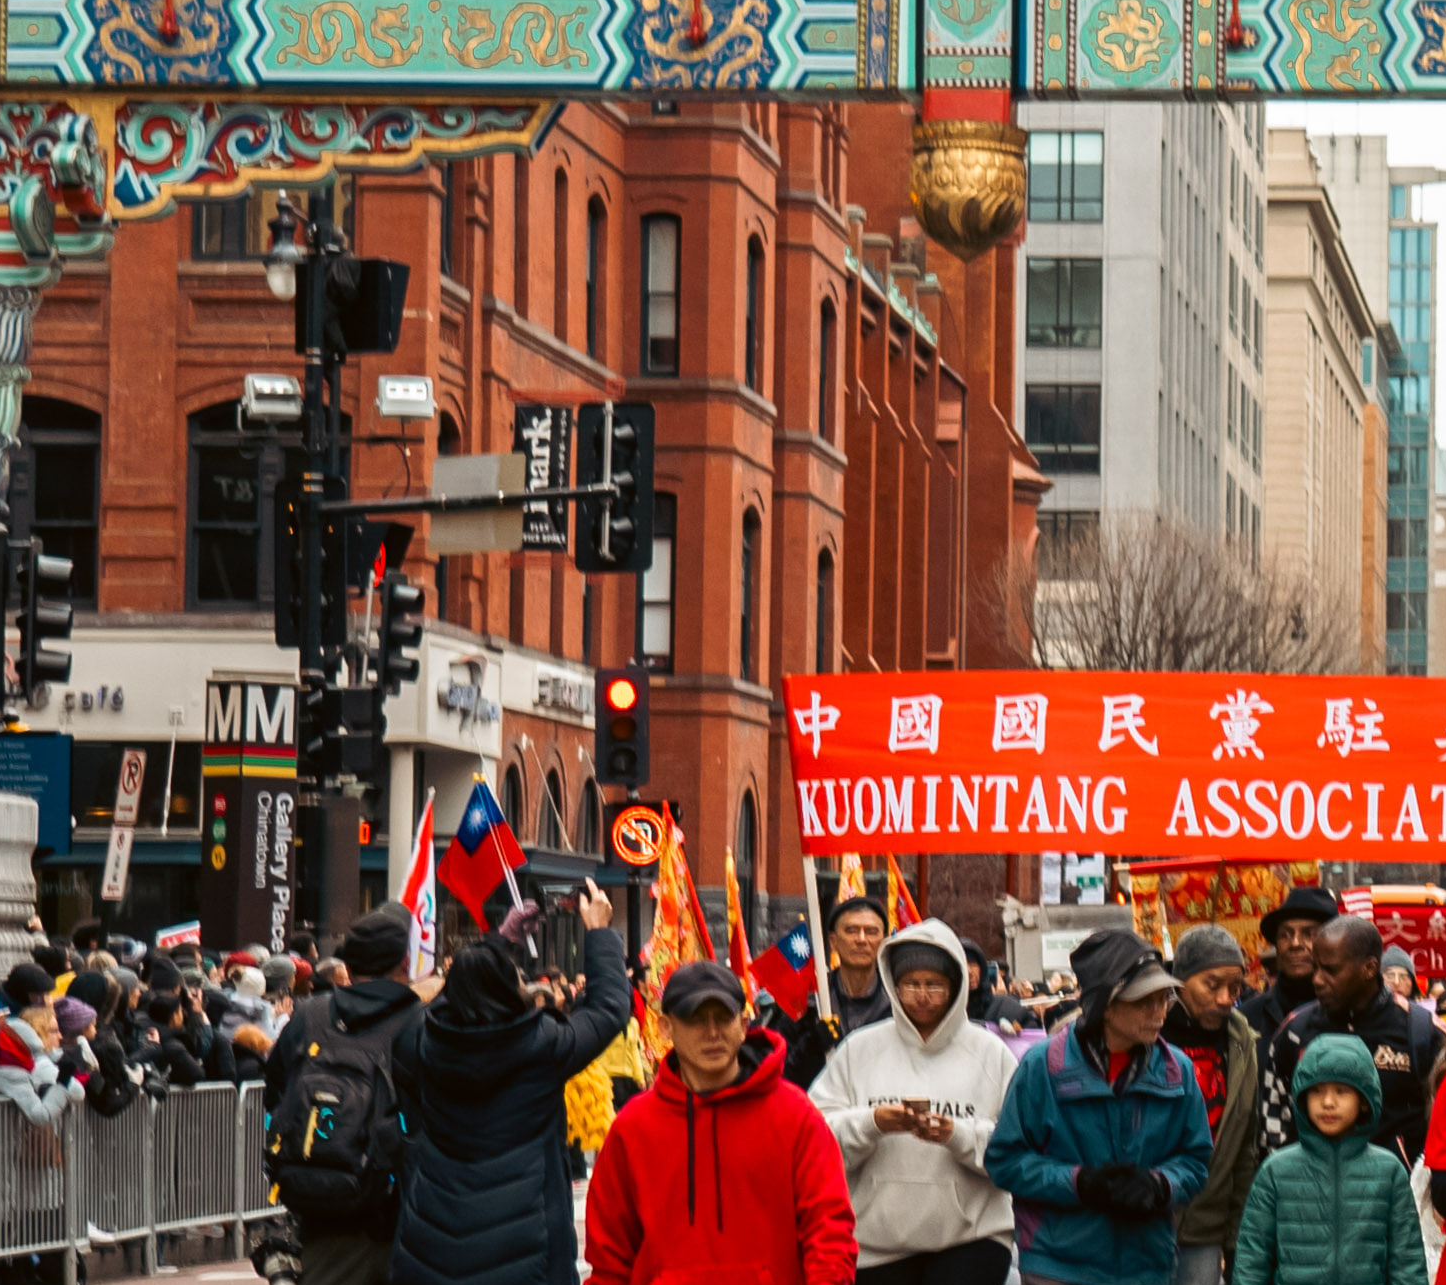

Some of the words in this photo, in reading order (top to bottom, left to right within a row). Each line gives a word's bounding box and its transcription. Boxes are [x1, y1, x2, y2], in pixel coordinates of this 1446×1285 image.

[207, 684, 242, 743] M
[246, 684, 295, 745] M
[256, 790, 273, 889] Chinatown
[270, 792, 294, 881] Gallery
[799, 775, 1128, 838] KUOMINTANG
[271, 885, 291, 954] Place
